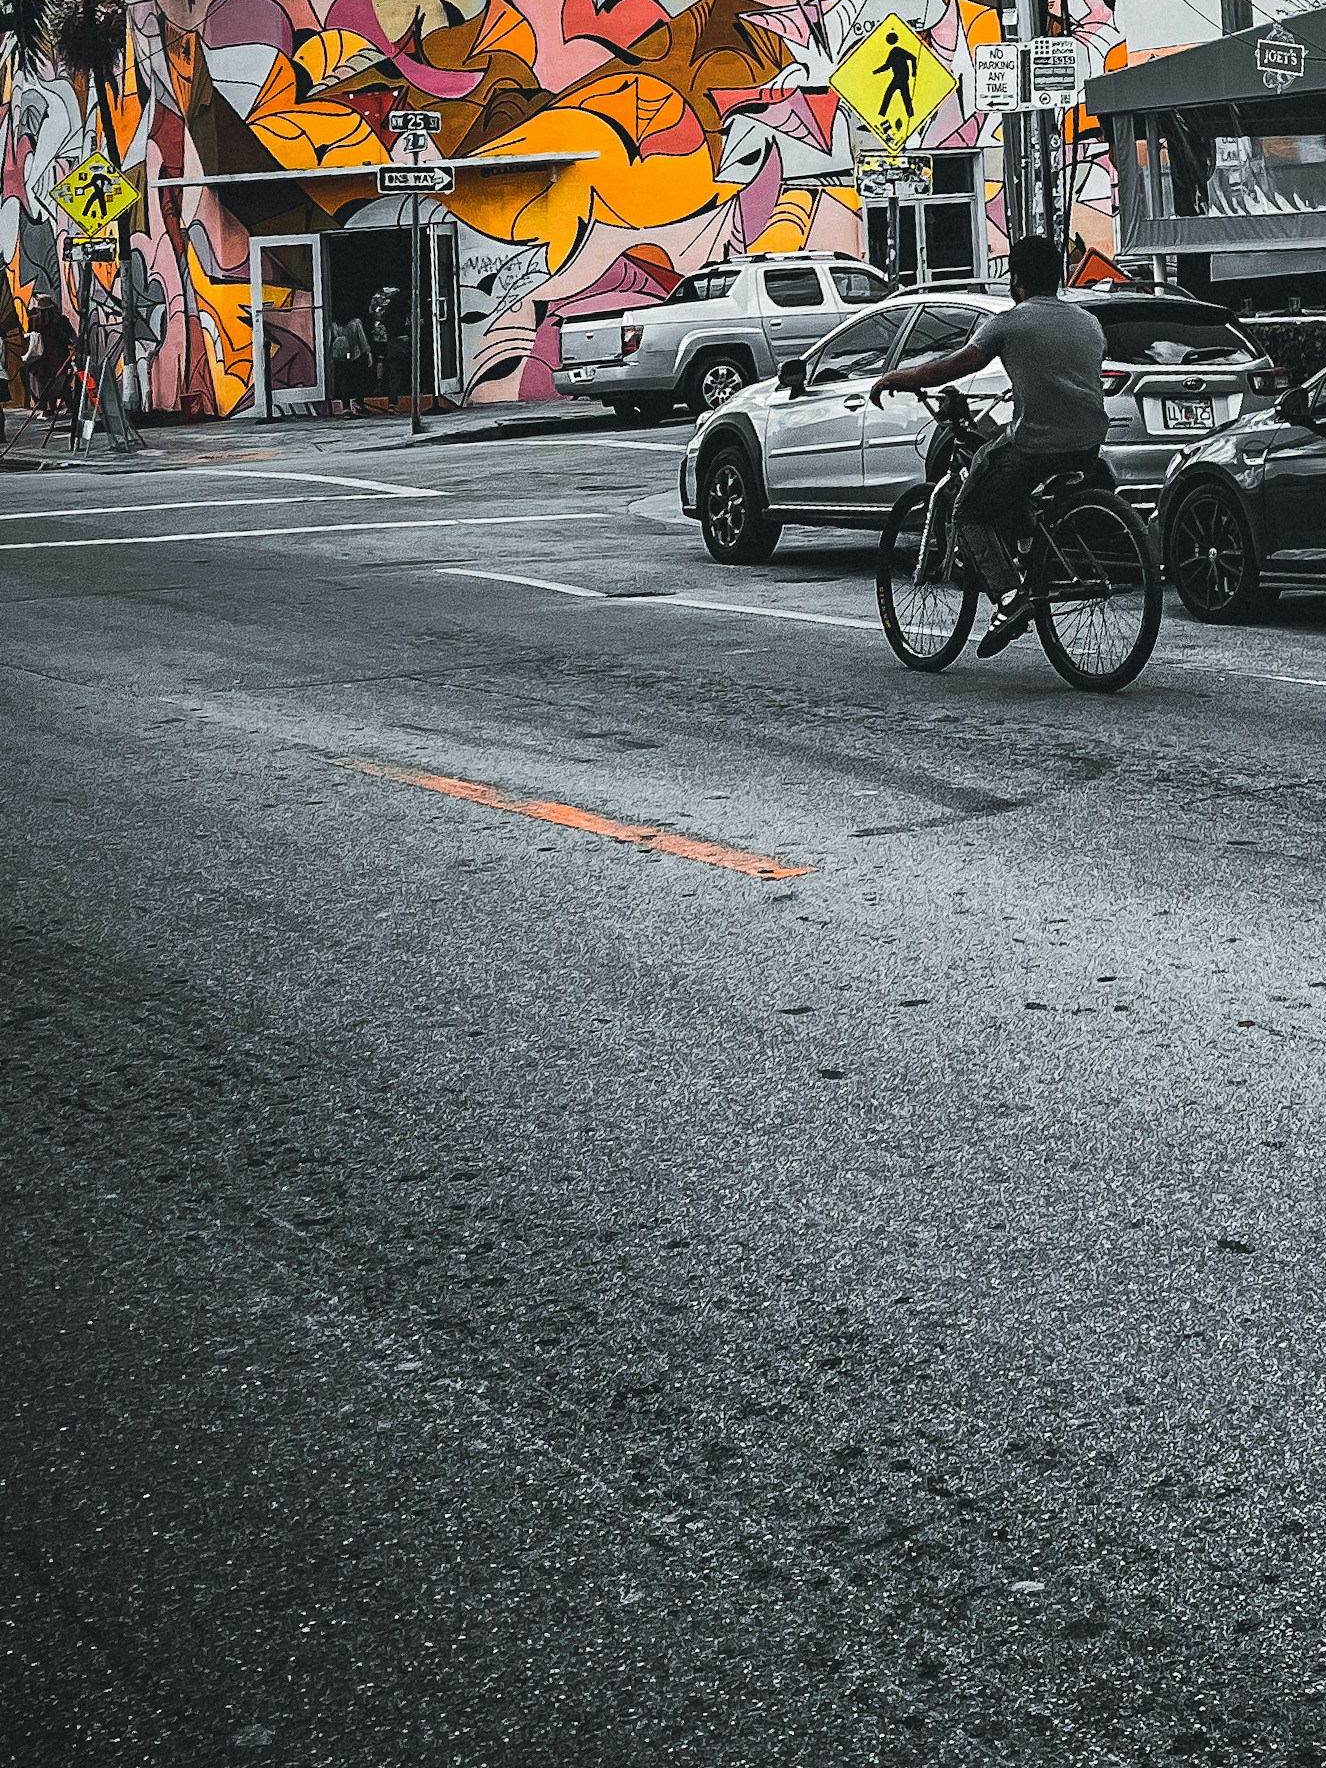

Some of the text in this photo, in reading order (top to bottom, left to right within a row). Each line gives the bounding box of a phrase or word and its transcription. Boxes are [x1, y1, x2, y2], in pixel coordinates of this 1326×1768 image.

[989, 48, 1004, 59] NO
[978, 61, 1015, 70] PARKING
[988, 72, 1006, 81] ANY
[986, 83, 1008, 93] TIME
[407, 114, 424, 130] 25
[413, 173, 435, 184] WAY
